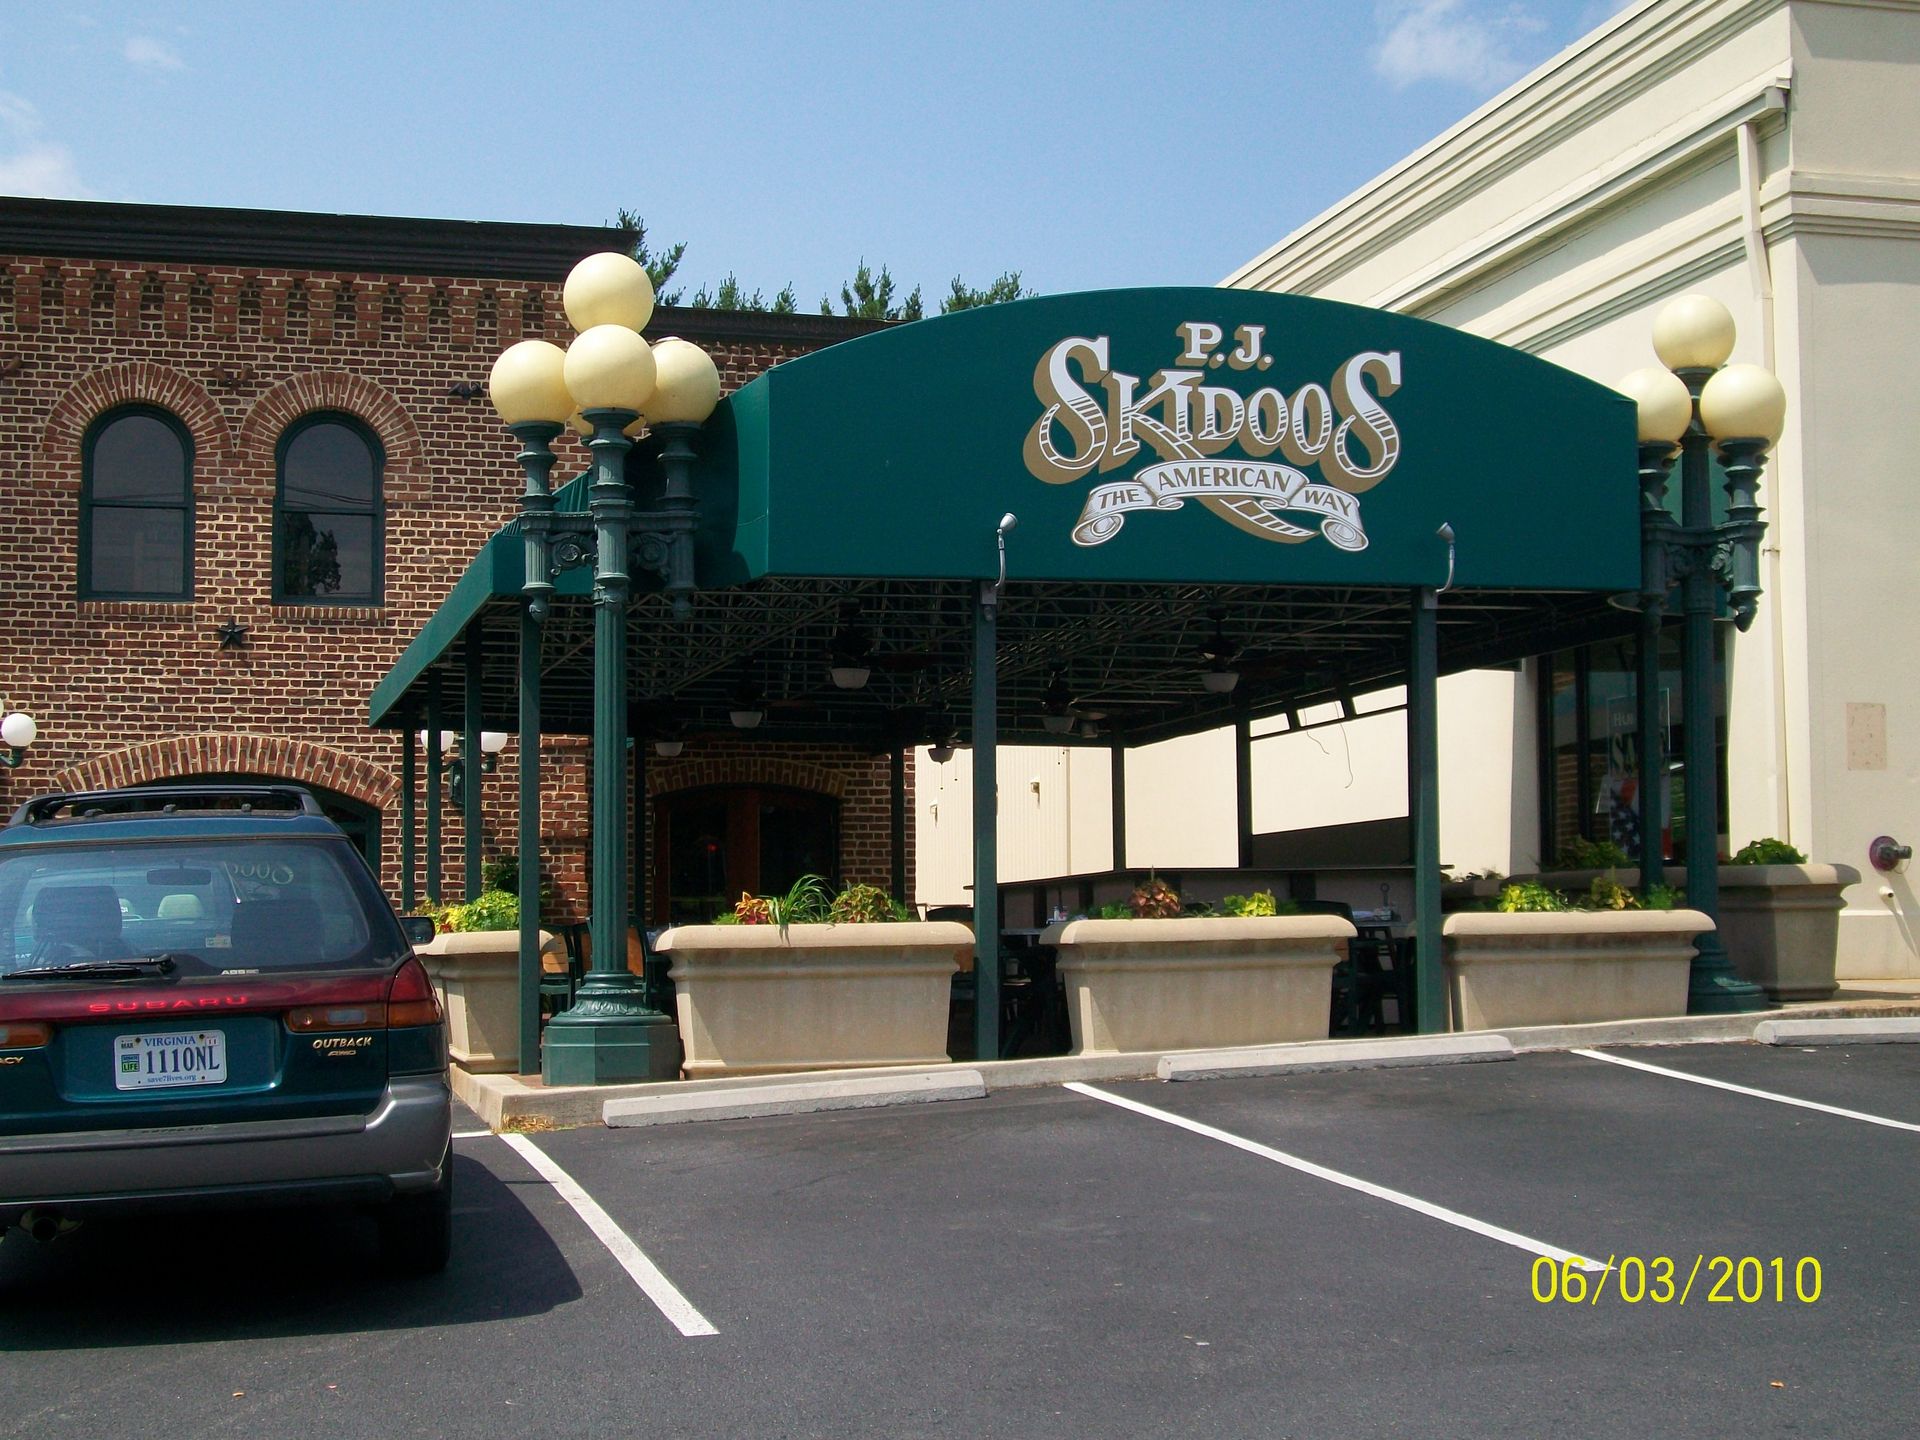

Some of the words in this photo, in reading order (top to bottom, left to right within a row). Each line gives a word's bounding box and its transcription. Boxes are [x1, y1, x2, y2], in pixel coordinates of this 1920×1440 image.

[1176, 321, 1274, 370] P.J.
[1023, 335, 1402, 494] SKIDOOS
[1098, 487, 1144, 509] THE
[1157, 465, 1292, 493] AMERICAN
[1304, 488, 1353, 517] WAY
[88, 996, 248, 1013] SUBARU
[144, 1035, 196, 1047] VIRGINIA
[312, 1036, 372, 1049] OUTBACK
[123, 1063, 139, 1071] LIFE
[147, 1074, 197, 1084] save7lives.org
